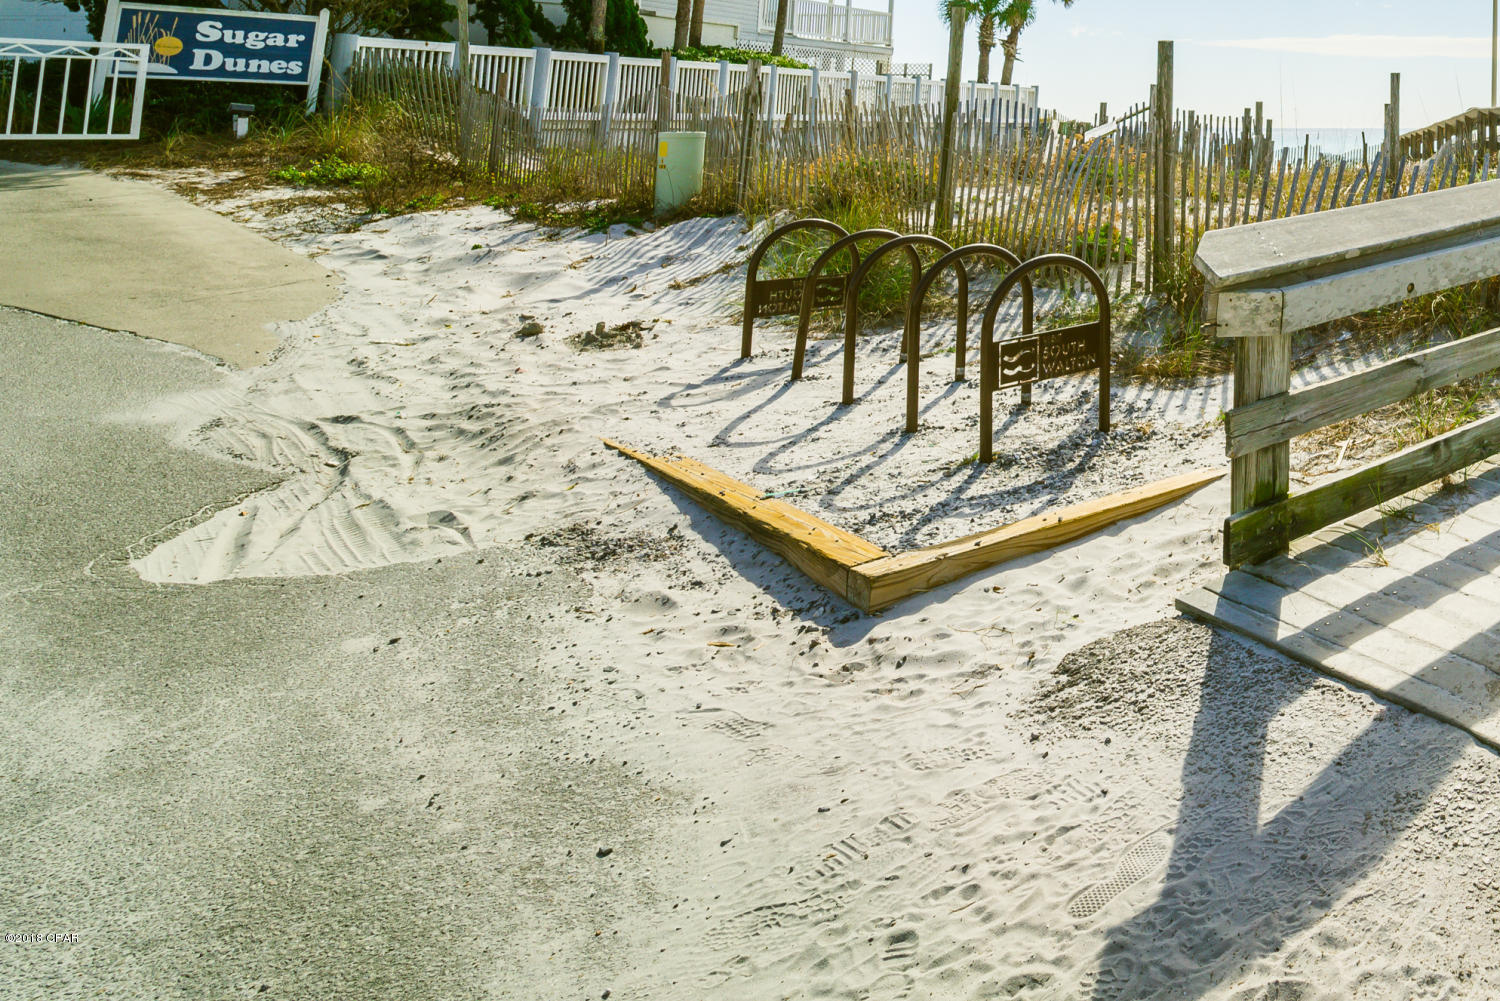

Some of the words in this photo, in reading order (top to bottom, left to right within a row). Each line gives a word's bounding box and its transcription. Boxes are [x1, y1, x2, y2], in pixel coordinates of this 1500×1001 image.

[195, 20, 306, 49] Sugar
[189, 48, 303, 75] Dunes
[1044, 340, 1086, 359] SOUTH
